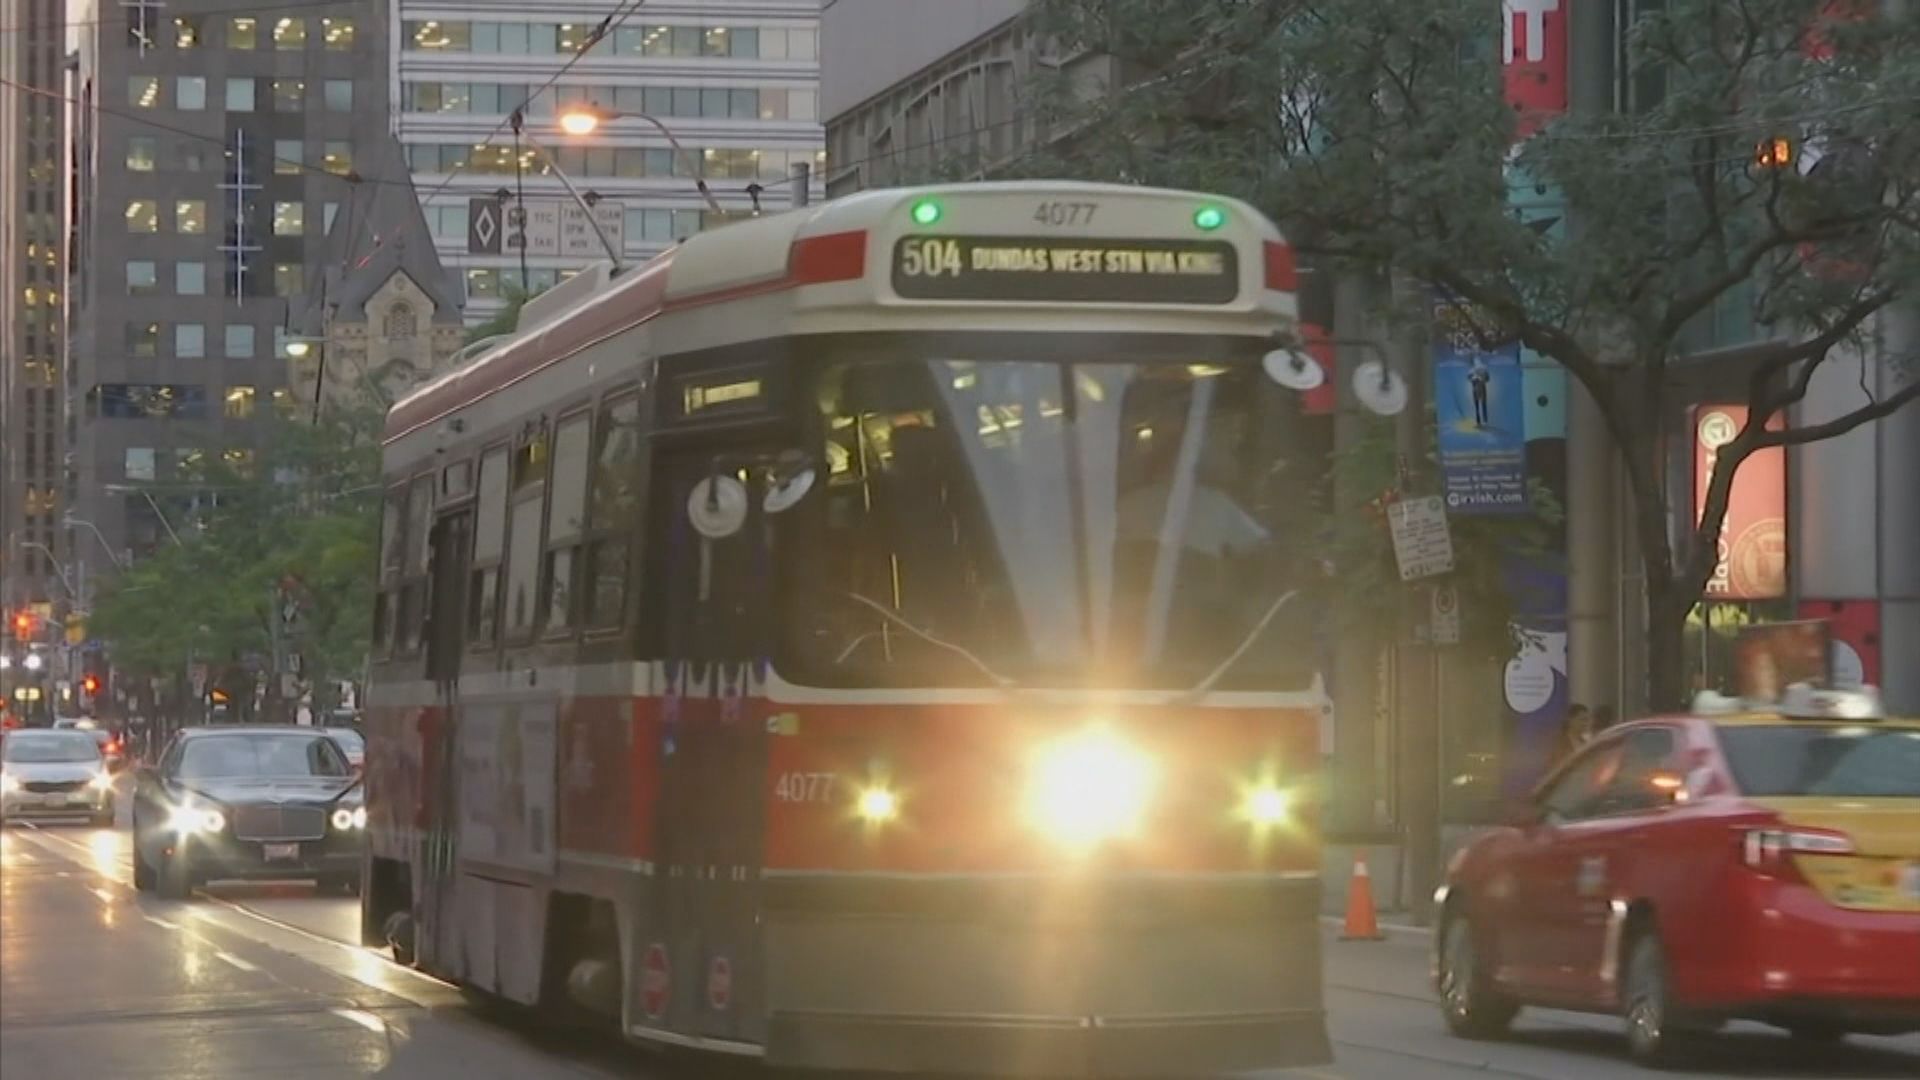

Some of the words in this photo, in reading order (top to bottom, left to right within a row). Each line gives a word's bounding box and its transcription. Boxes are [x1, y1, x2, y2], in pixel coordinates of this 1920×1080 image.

[1033, 203, 1098, 226] 4077
[902, 239, 961, 277] 504
[971, 247, 1050, 272] DUNDAS
[1050, 249, 1103, 273] WEST
[1105, 250, 1144, 274] STN
[1145, 251, 1177, 274] VIA
[776, 771, 836, 802] 4077
